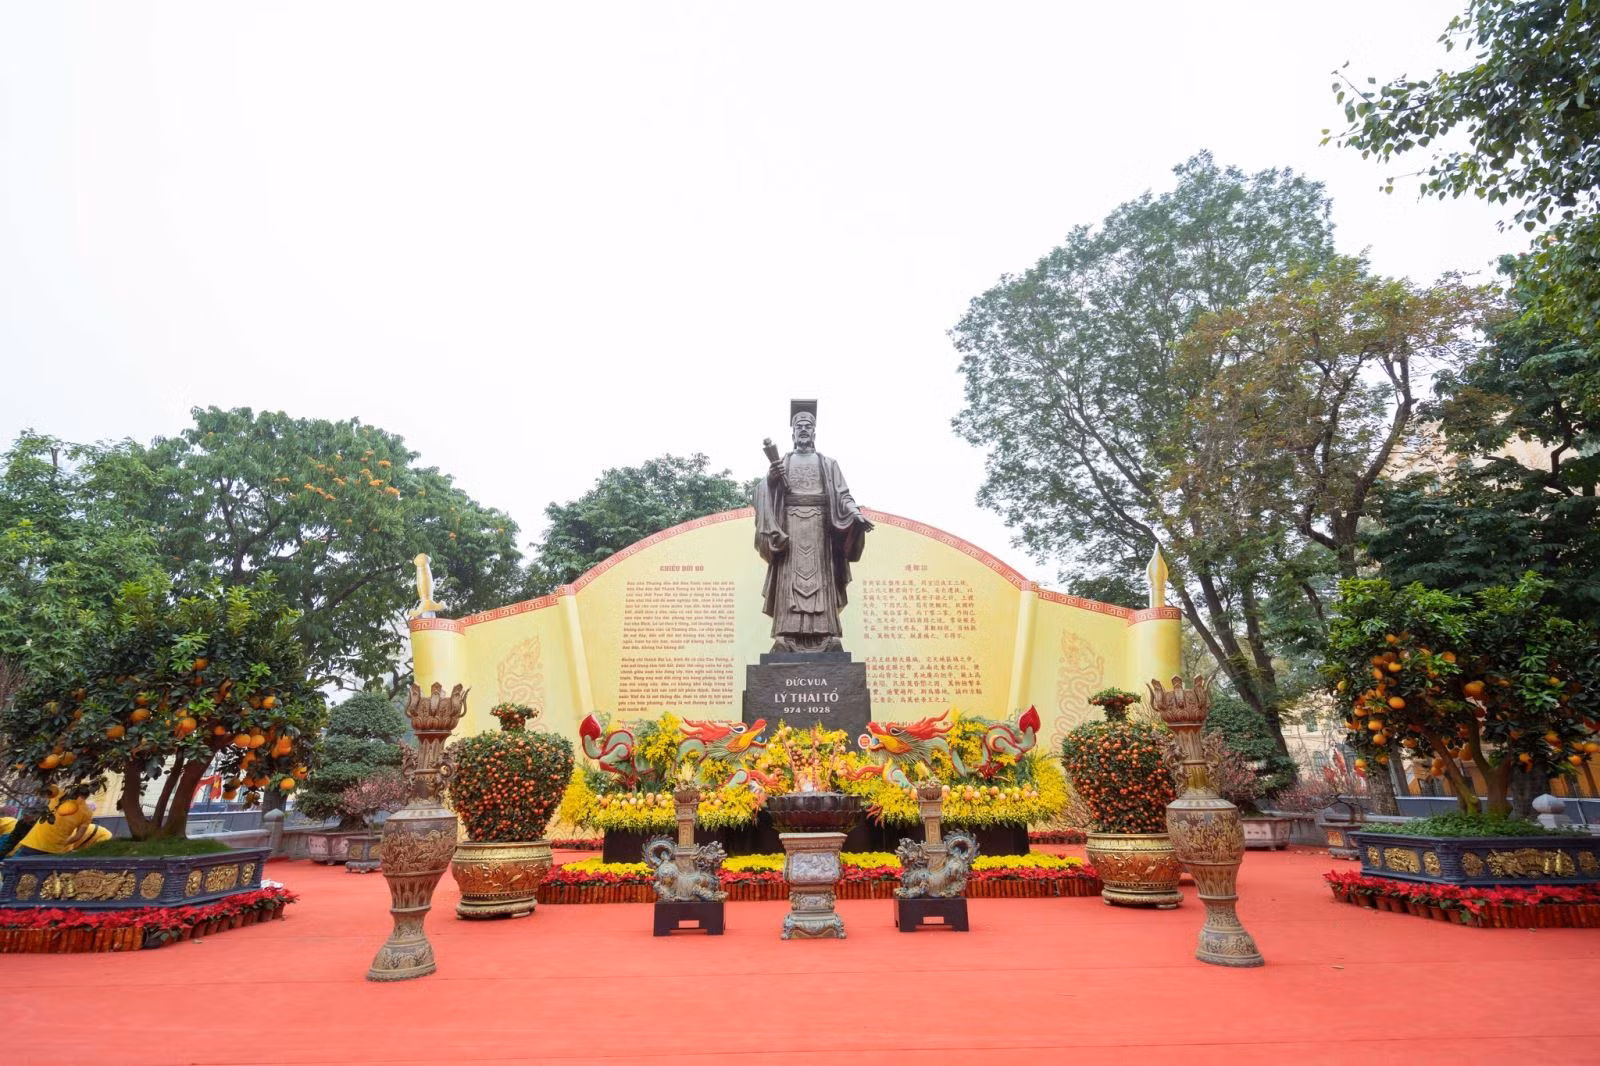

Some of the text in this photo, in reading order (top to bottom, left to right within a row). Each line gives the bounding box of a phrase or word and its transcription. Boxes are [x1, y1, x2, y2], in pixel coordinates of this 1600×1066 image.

[786, 677, 828, 686] ĐỨC VUA
[774, 687, 839, 703] LÝ THÁI TỔ
